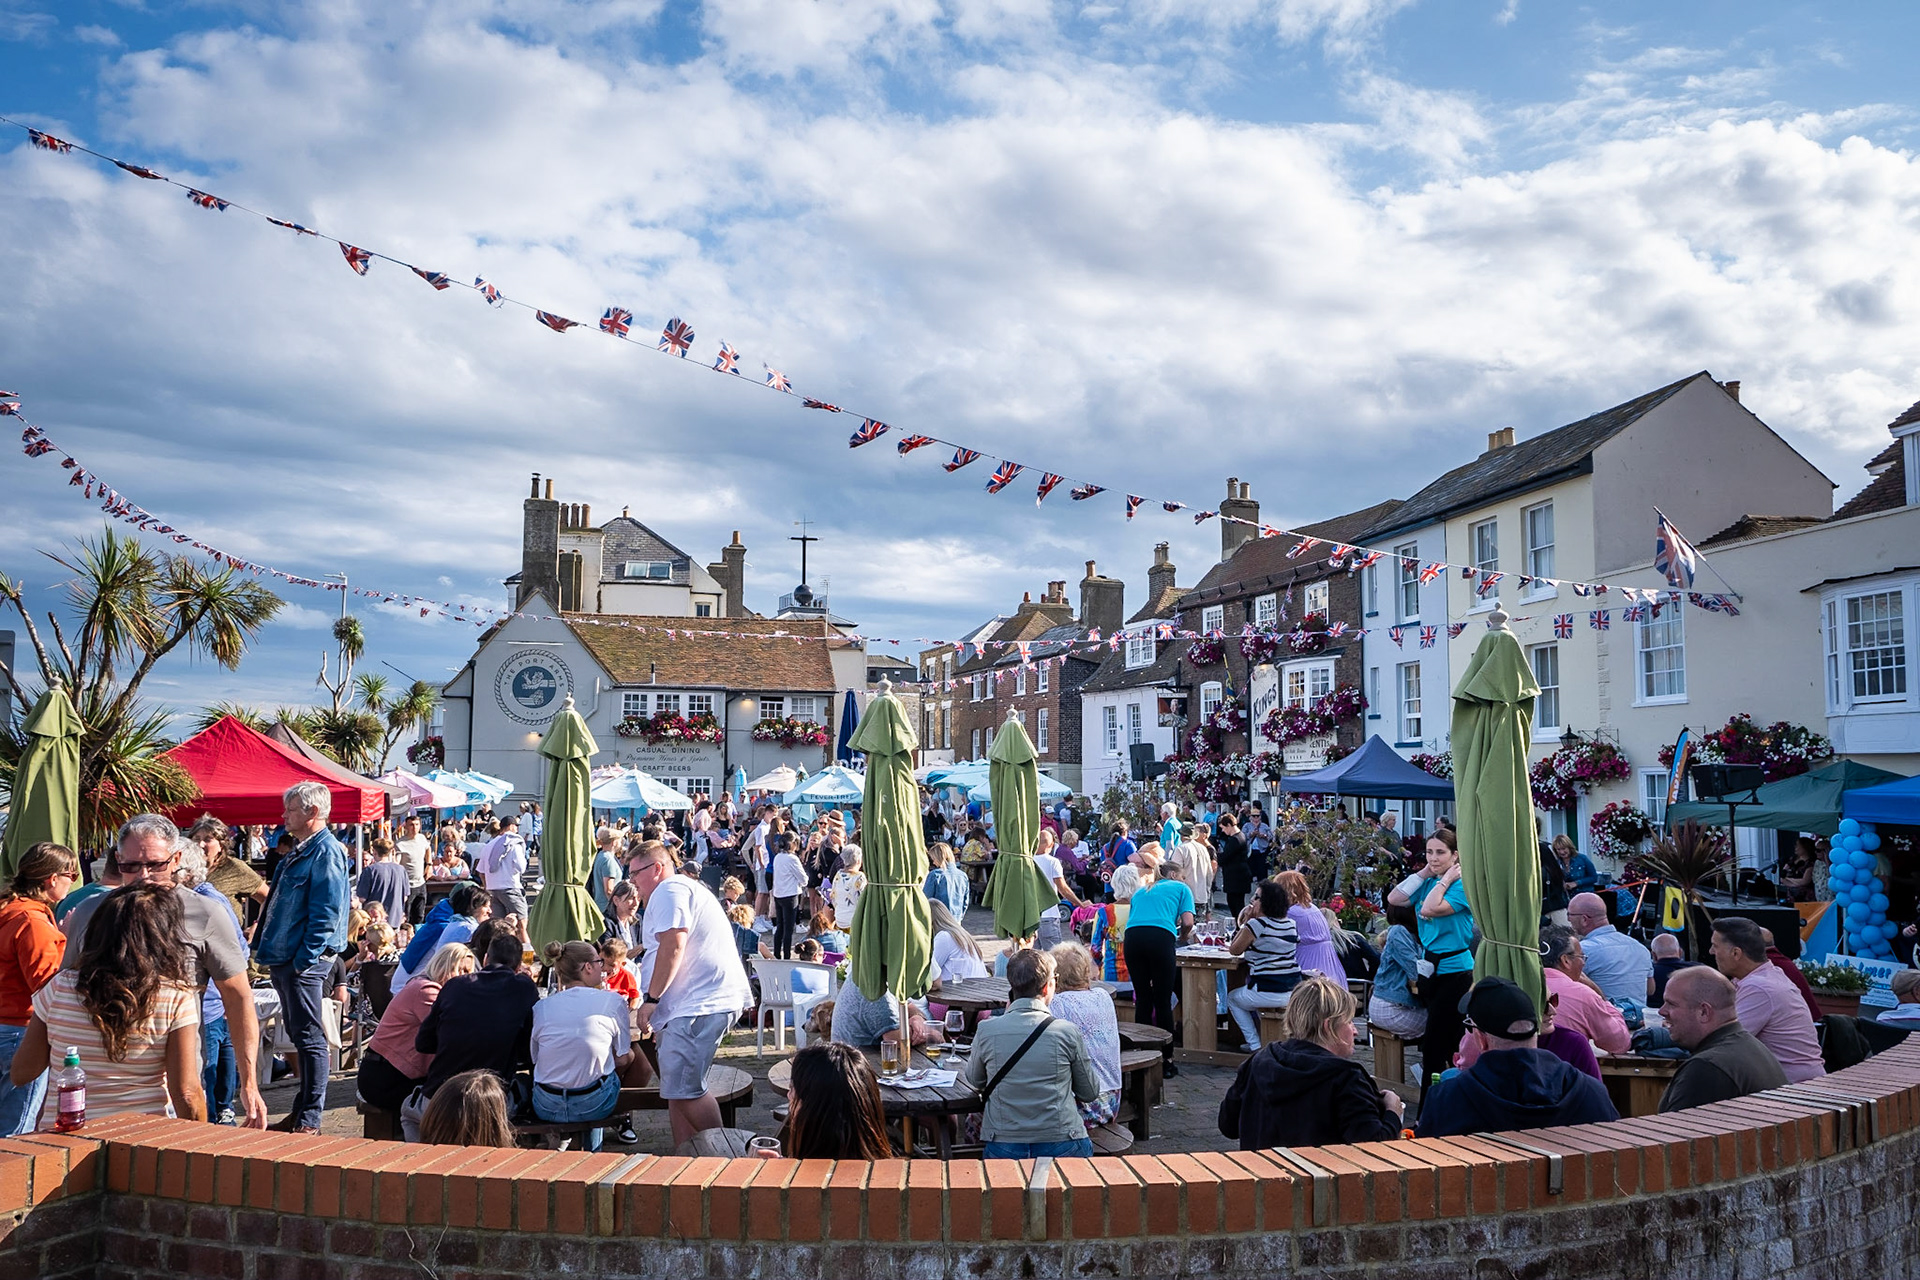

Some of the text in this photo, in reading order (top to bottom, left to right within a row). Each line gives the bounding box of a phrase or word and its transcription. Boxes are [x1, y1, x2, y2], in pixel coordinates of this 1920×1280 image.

[504, 658, 564, 687] THE PORT ARMS
[650, 799, 687, 808] FEVER-TREE
